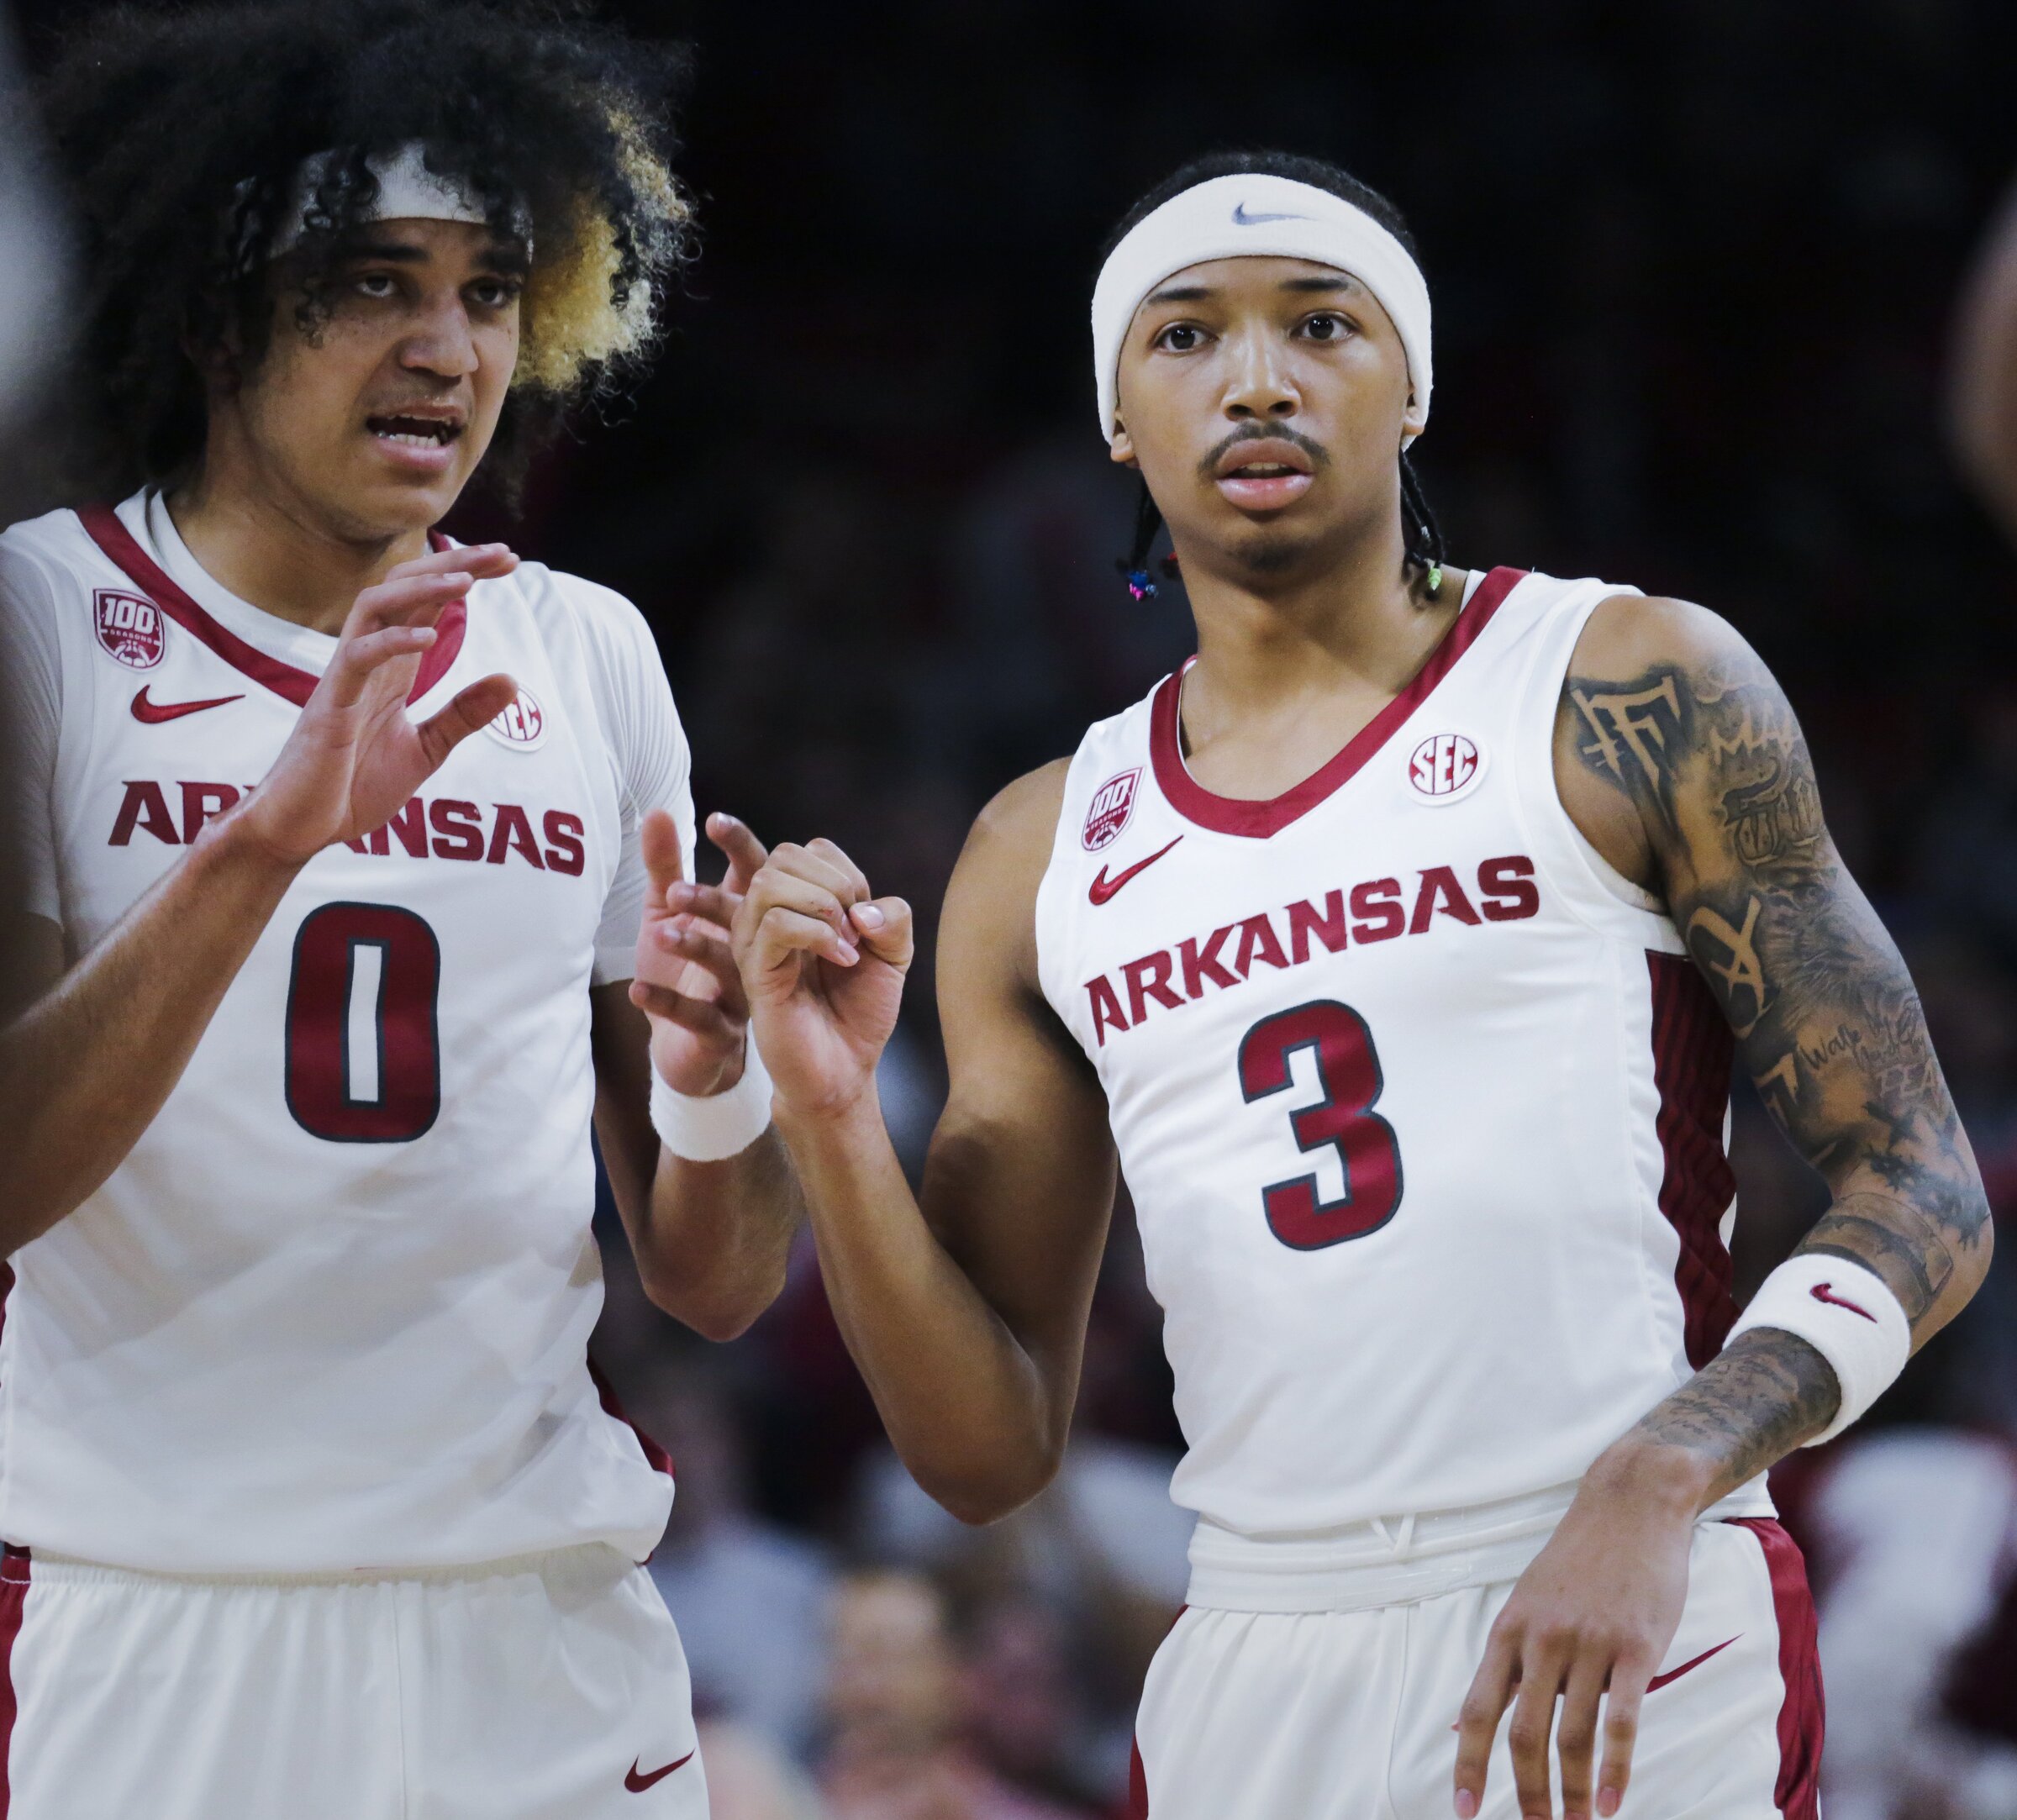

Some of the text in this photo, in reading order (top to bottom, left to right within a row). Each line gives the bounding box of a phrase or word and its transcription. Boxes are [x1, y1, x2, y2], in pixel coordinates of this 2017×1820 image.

[104, 597, 155, 635] 100
[109, 629, 153, 644] SEASONS
[1087, 776, 1133, 824] 100
[1410, 734, 1477, 796] SEC
[108, 781, 586, 877] ARNSAS
[1083, 855, 1540, 1048] ARKANSAS
[284, 901, 441, 1144] 0
[1238, 998, 1404, 1252] 3
